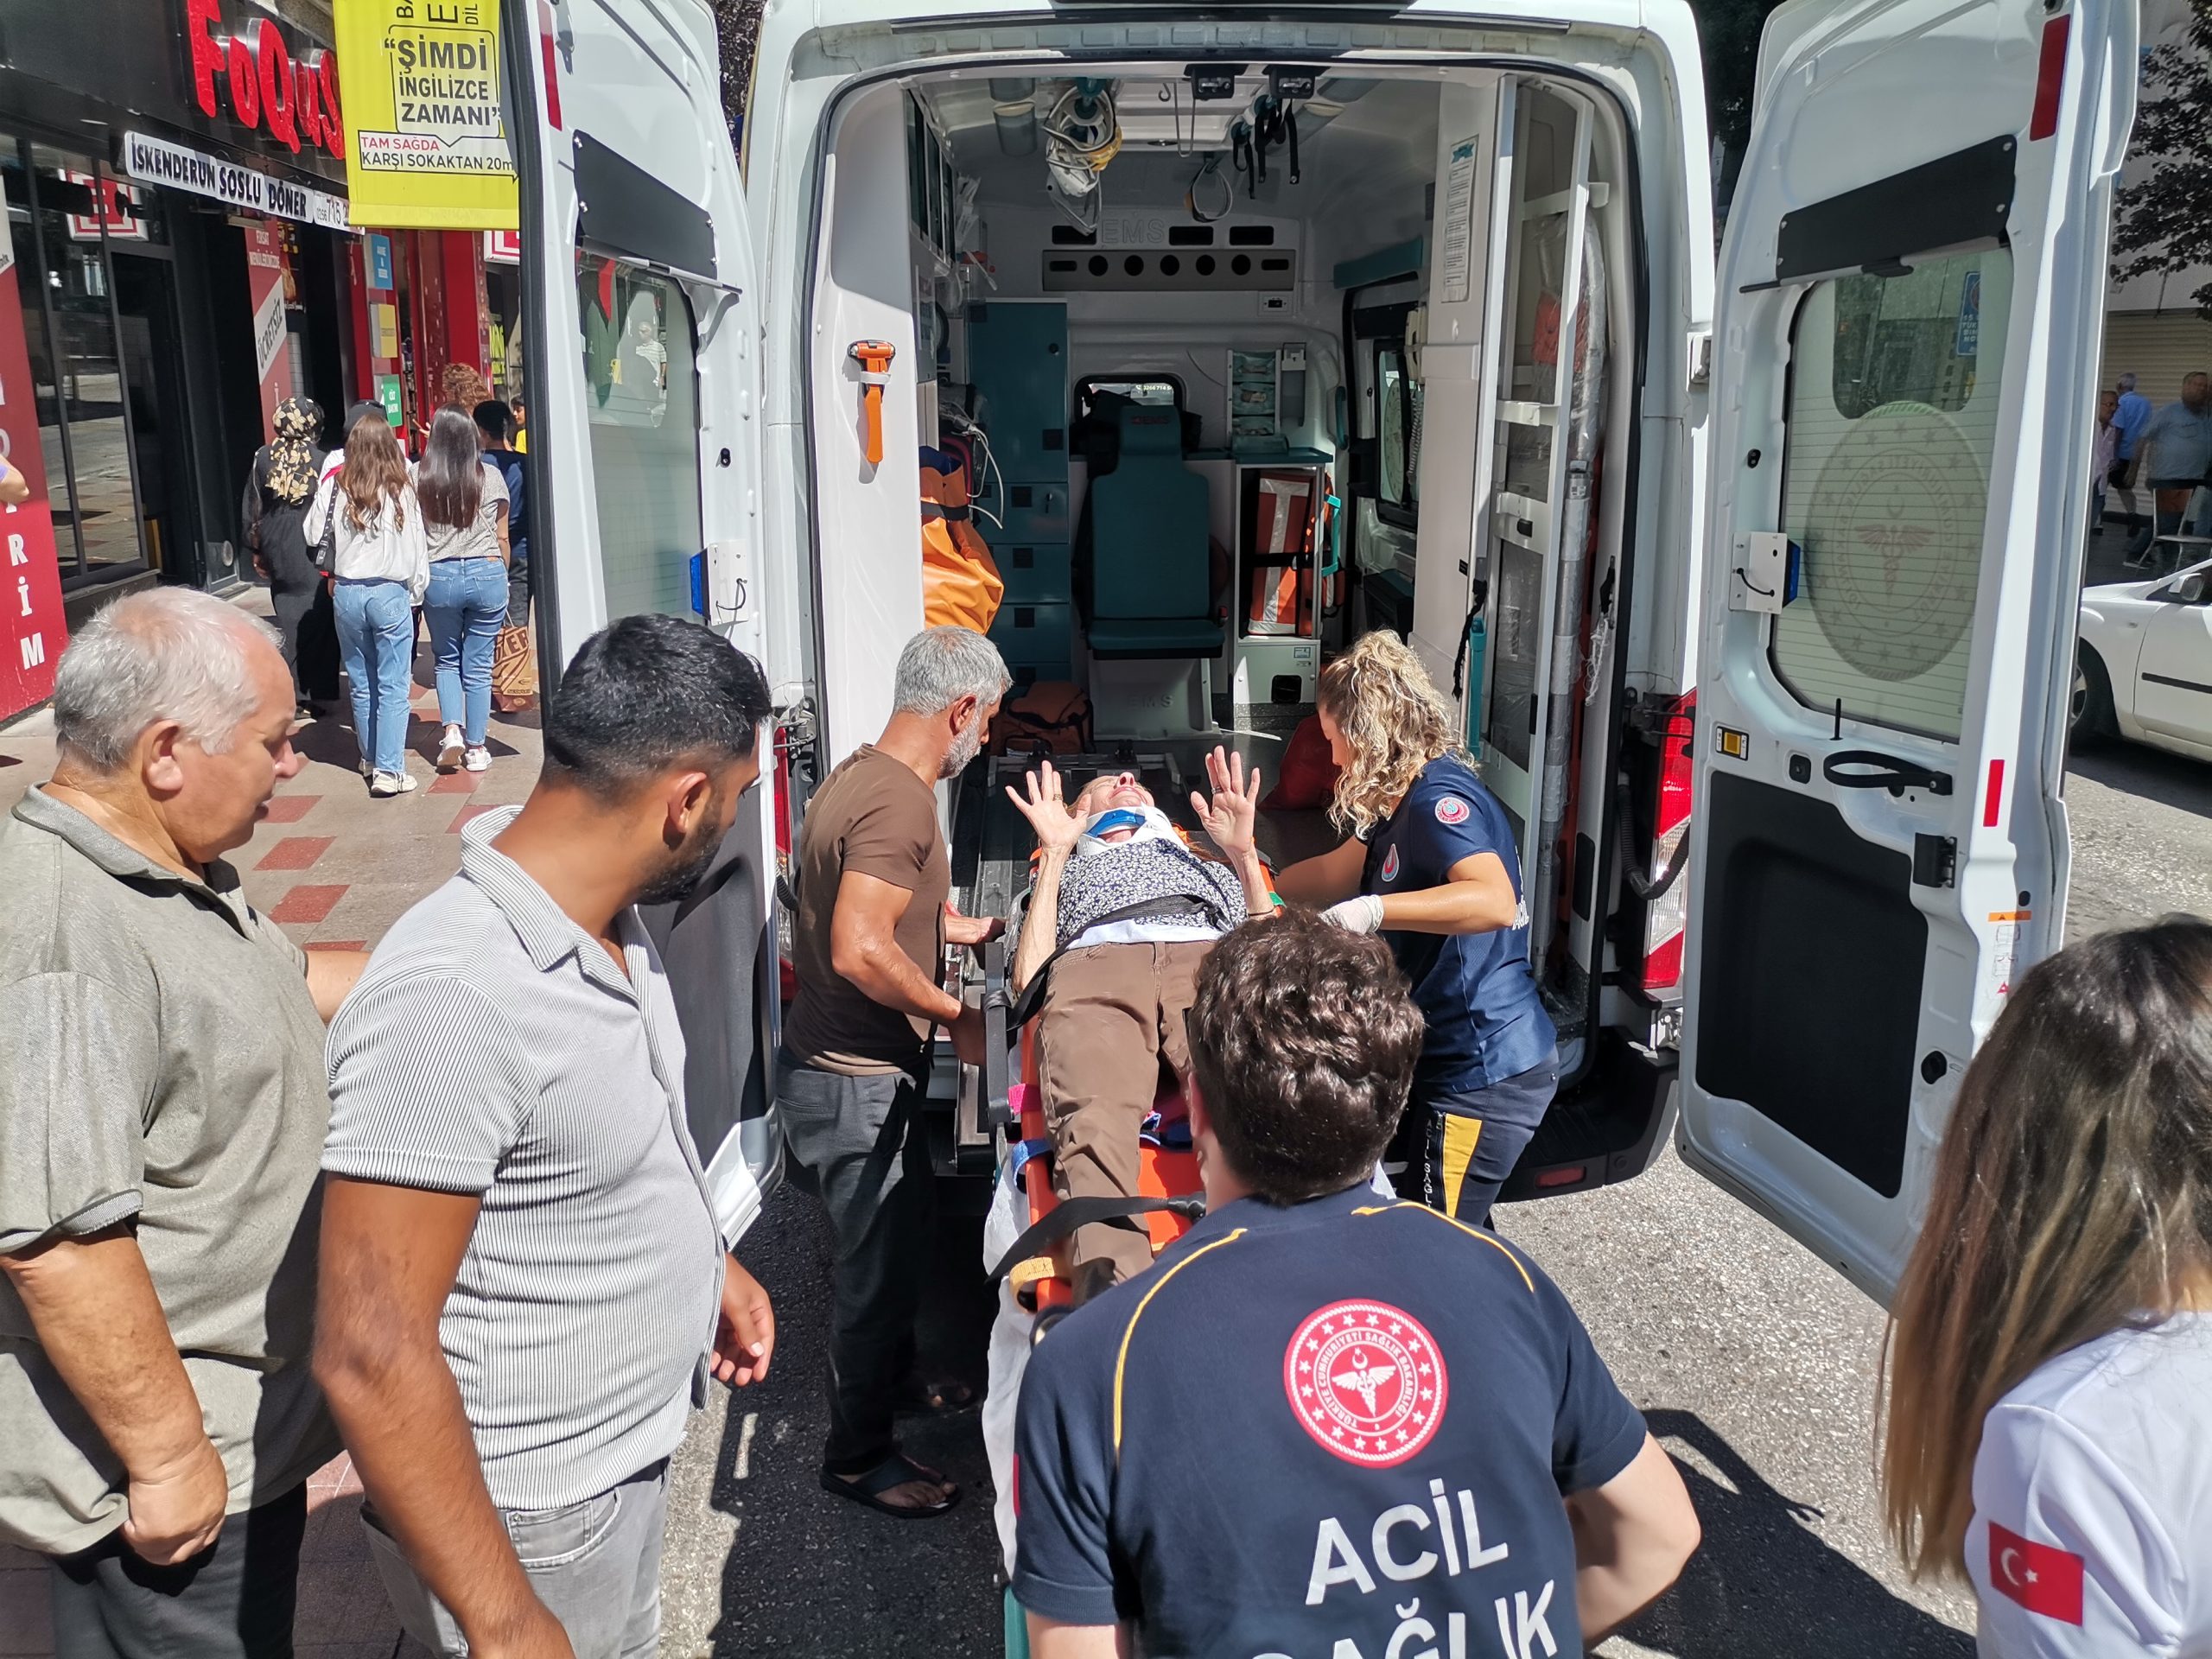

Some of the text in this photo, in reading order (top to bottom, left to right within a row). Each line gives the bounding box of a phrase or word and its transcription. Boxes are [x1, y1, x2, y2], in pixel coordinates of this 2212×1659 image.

[398, 72, 489, 100] İNGİLİZCE
[360, 137, 440, 151] TAM SAĞDA
[361, 151, 404, 170] KARŞI
[407, 154, 483, 170] SOKAKTAN
[130, 132, 216, 189] İSKENDERUN
[219, 166, 262, 205] SOSLU
[268, 180, 308, 219] DÖNER
[1102, 218, 1166, 245] EMS
[257, 296, 283, 370] ÜCRETSİZ
[1317, 1330, 1363, 1387] CUMHURİYETİ
[1305, 1478, 1509, 1605] ACİL
[1250, 1579, 1558, 1659] ĞLIK
